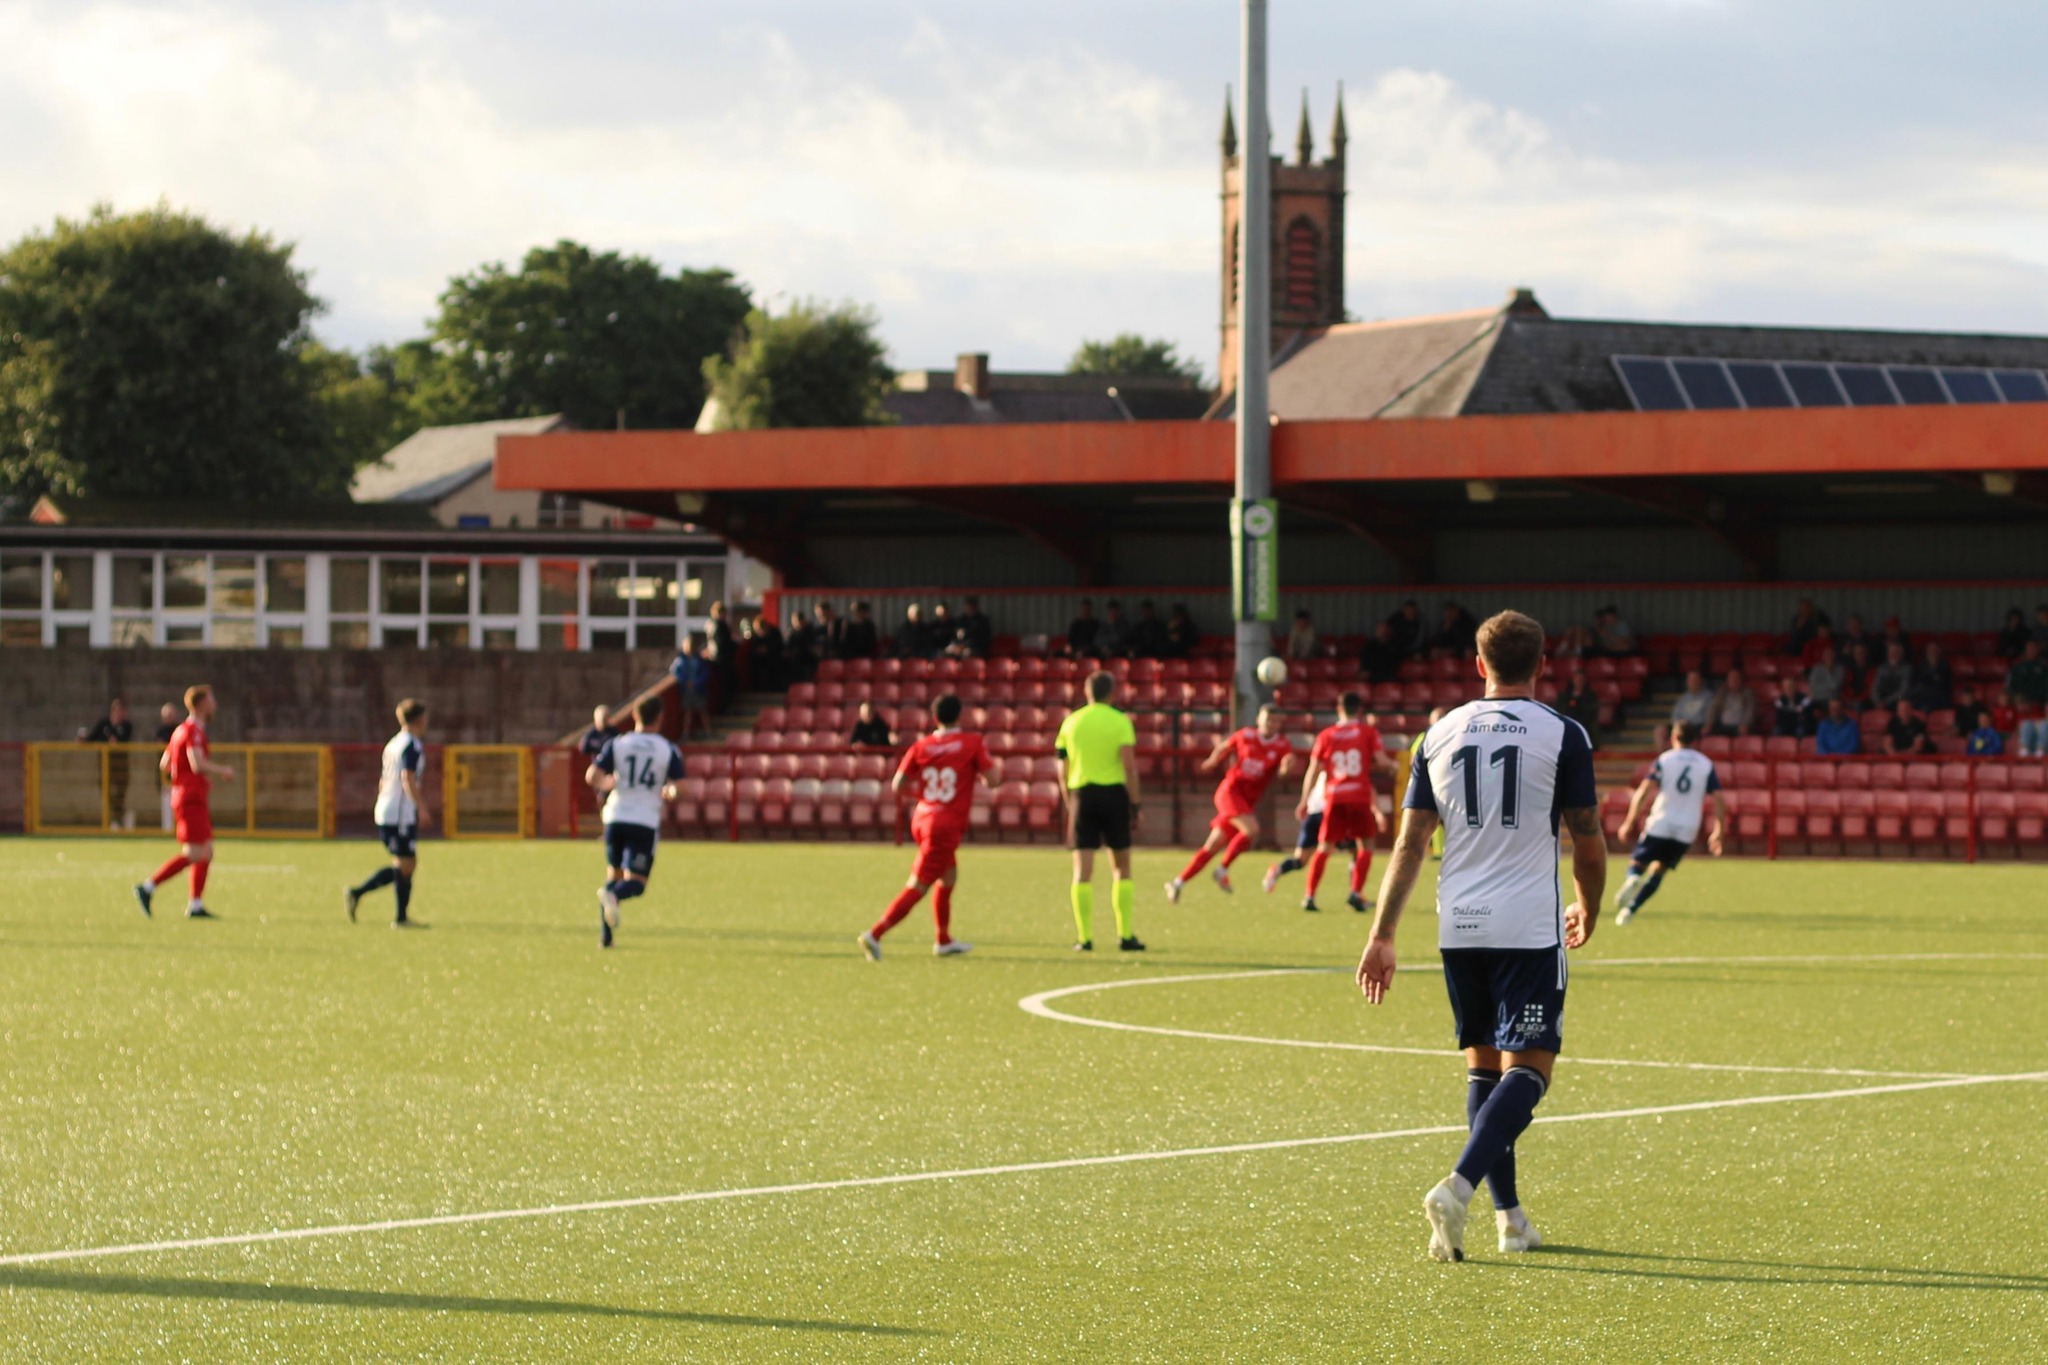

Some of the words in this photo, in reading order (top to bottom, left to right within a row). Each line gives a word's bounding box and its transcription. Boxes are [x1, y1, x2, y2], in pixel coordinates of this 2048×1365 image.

[1463, 723, 1527, 735] Jameson
[625, 755, 656, 790] 14
[1332, 749, 1361, 776] 38
[922, 766, 957, 803] 33
[1451, 745, 1522, 829] 11
[1676, 765, 1692, 794] 6
[1452, 905, 1493, 916] Dalzells
